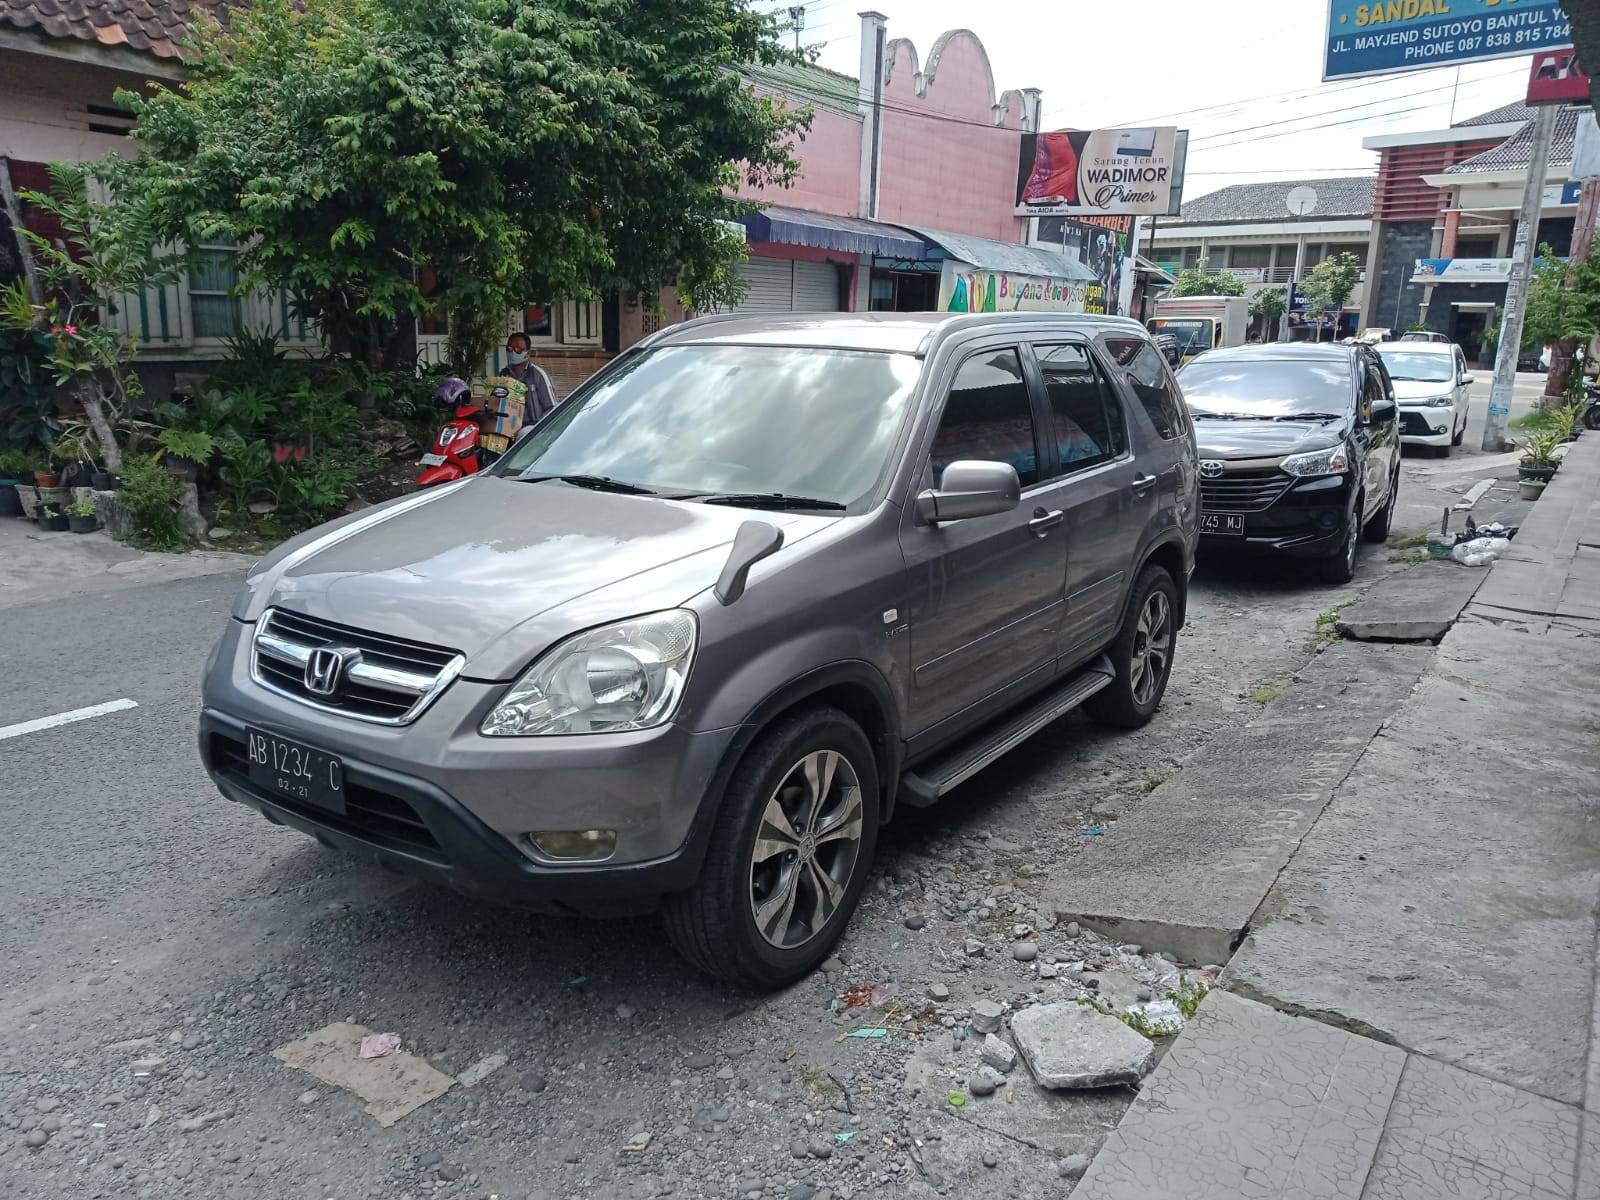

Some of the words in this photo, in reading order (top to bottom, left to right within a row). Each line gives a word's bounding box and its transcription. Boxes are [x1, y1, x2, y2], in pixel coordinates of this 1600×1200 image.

[1355, 0, 1449, 26] SANDAL
[1333, 41, 1351, 53] JL.
[1355, 30, 1418, 50] MAYJEND
[1422, 19, 1481, 40] SUTOYO
[1487, 10, 1548, 30] BANTUL
[1405, 41, 1454, 59] PHONE
[1458, 37, 1482, 51] 087
[1486, 33, 1511, 47] 838
[1515, 28, 1540, 43] 815
[1094, 157, 1129, 166] Sarung
[1134, 156, 1164, 165] Tenun
[1088, 167, 1167, 183] WADIMOR
[1093, 184, 1157, 209] Primer
[1227, 516, 1242, 529] MJ
[249, 733, 267, 764] AB
[272, 741, 312, 781] 1234
[329, 760, 340, 791] C
